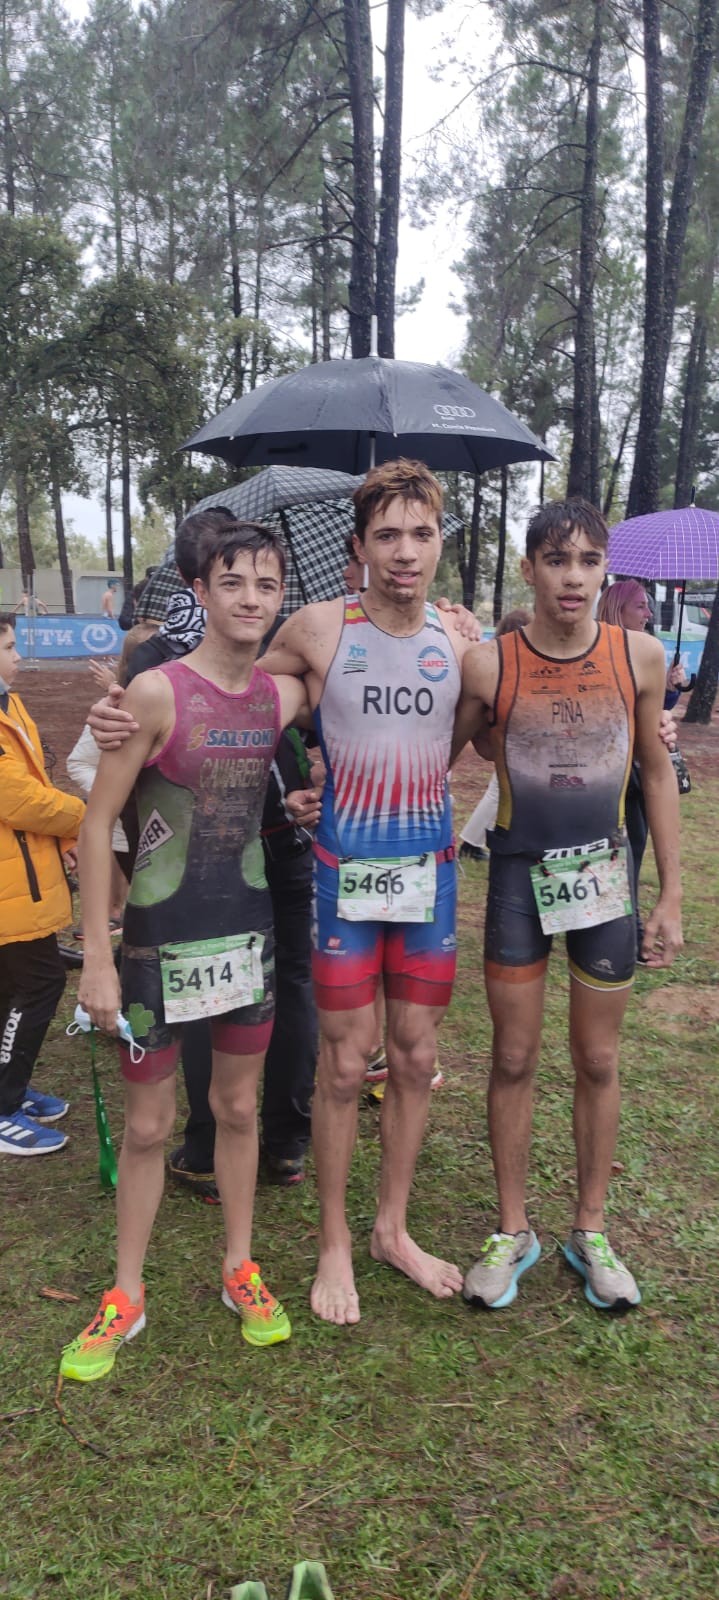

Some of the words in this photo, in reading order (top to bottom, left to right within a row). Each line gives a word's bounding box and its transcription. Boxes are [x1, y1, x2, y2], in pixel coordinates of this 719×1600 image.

[362, 685, 434, 716] RICO
[343, 871, 405, 896] 5466
[540, 876, 601, 907] 5461
[168, 960, 233, 993] 5414
